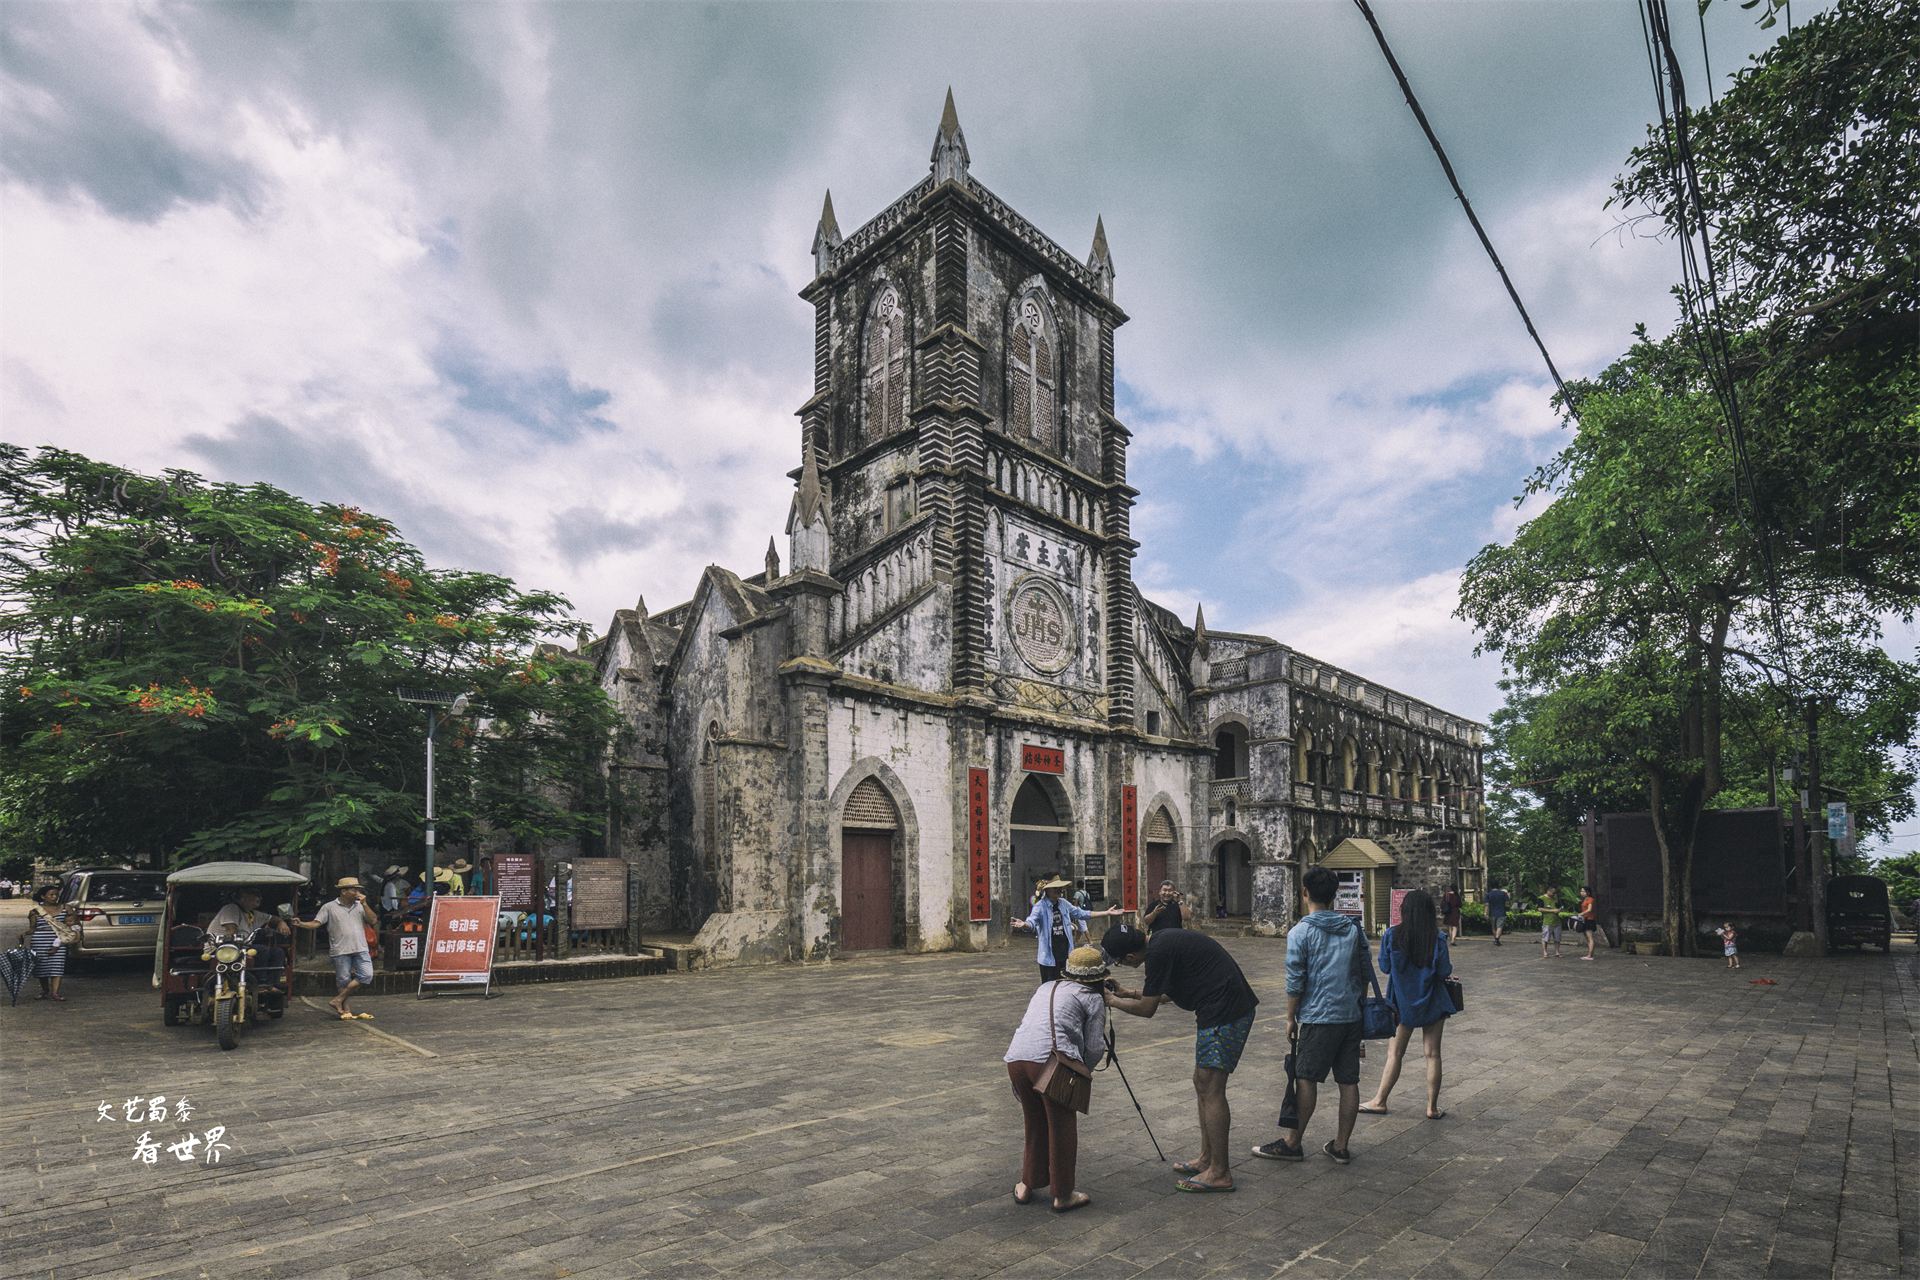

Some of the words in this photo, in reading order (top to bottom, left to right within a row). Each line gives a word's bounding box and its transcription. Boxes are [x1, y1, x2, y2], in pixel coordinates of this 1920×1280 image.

[1016, 612, 1060, 645] JHS
[449, 919, 479, 932] 电动车
[436, 940, 486, 953] 临时停车点
